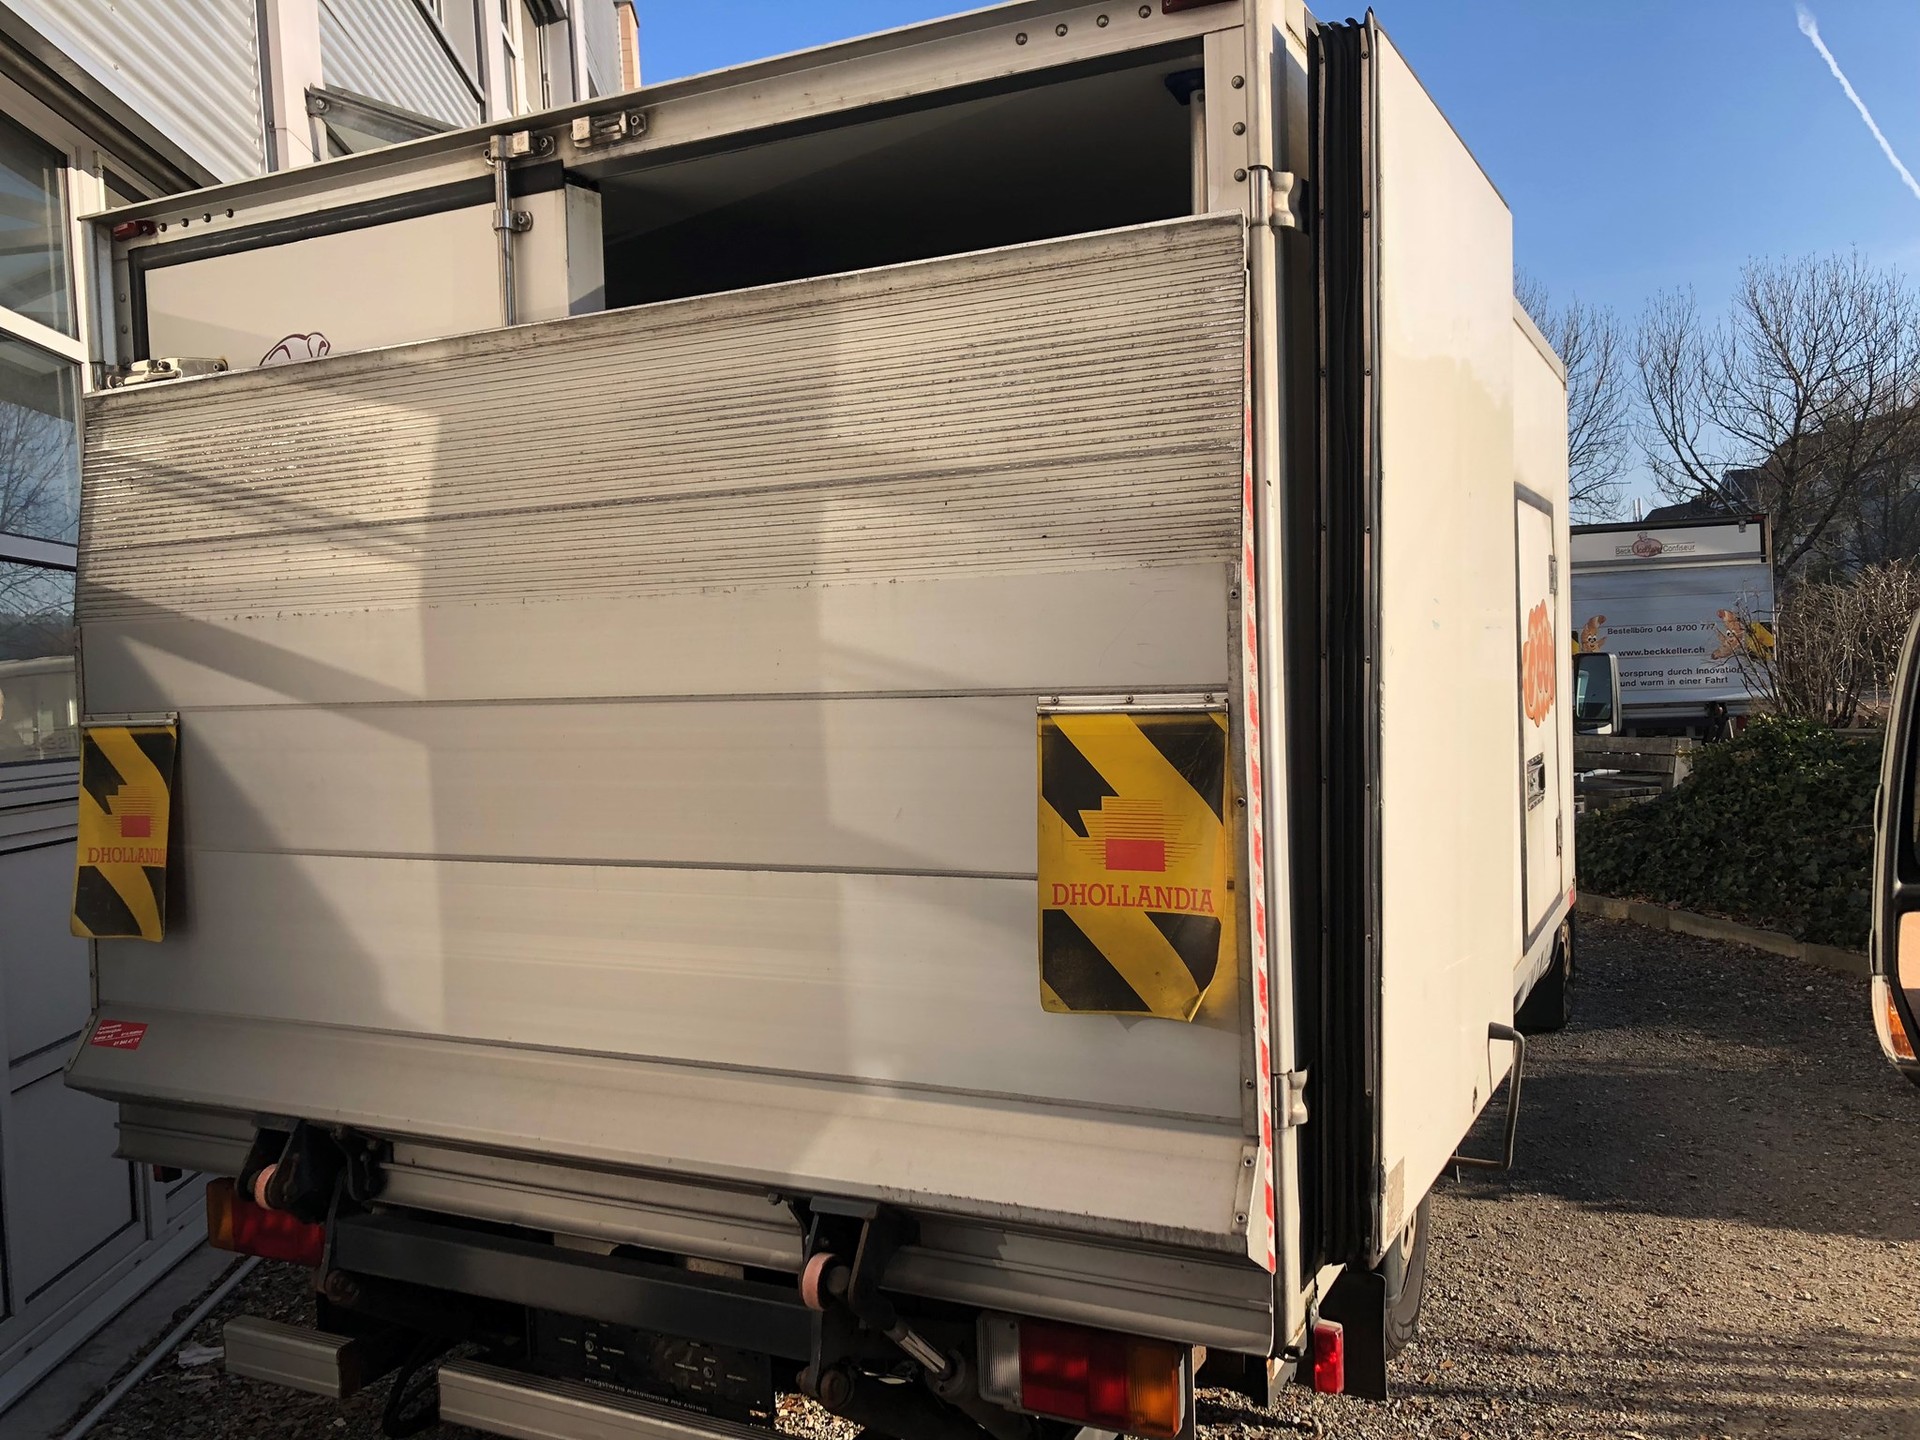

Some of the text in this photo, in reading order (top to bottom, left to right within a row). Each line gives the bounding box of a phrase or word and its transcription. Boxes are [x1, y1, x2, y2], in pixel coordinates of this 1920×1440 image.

[1607, 626, 1653, 635] Bestellbüro
[1656, 625, 1673, 633] 044
[1676, 624, 1697, 632] 8700
[1618, 646, 1705, 657] www.beckkeller.ch
[1667, 667, 1692, 676] durch
[1620, 679, 1636, 687] und
[1668, 677, 1675, 685] in
[1679, 676, 1702, 685] einer
[1705, 675, 1728, 684] Fahrt
[1051, 883, 1214, 913] DHOLLANDIA
